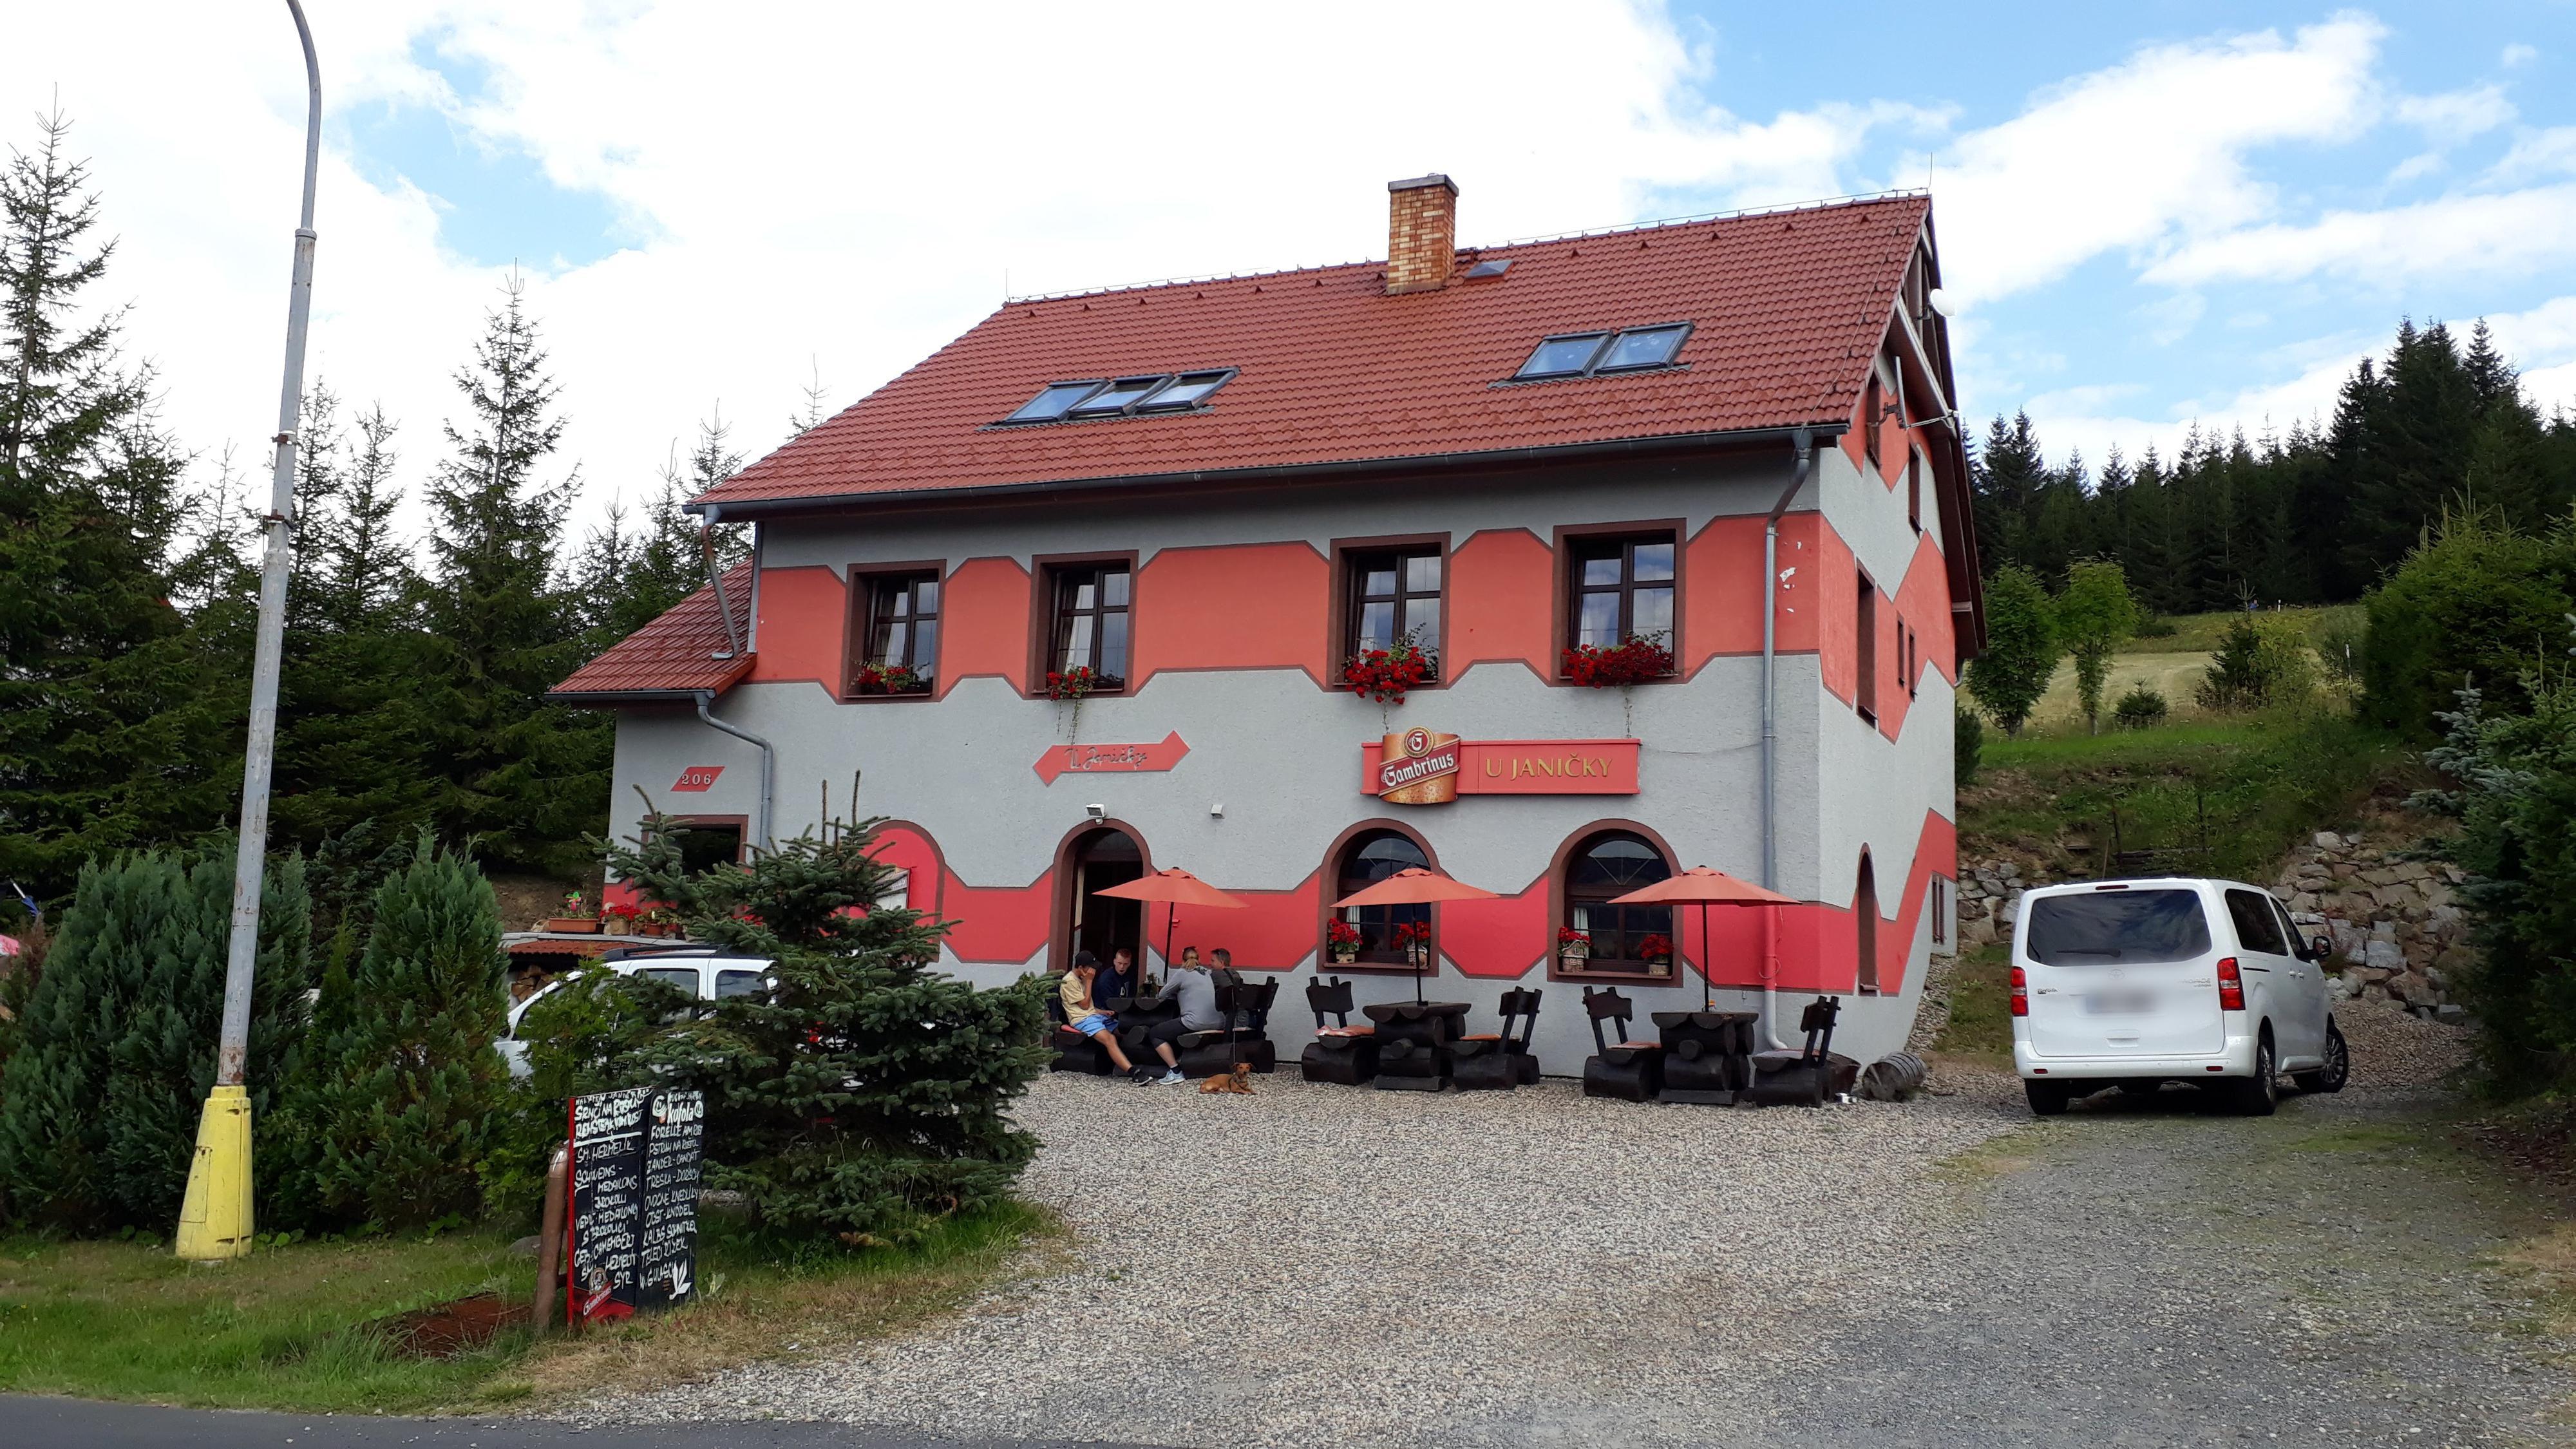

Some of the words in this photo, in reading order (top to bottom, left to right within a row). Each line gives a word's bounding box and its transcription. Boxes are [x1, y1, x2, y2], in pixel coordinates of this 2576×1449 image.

[681, 773, 712, 785] 206
[1381, 754, 1454, 787] Gambrinus
[1486, 759, 1502, 777] U
[1511, 752, 1613, 781] JANIČKY
